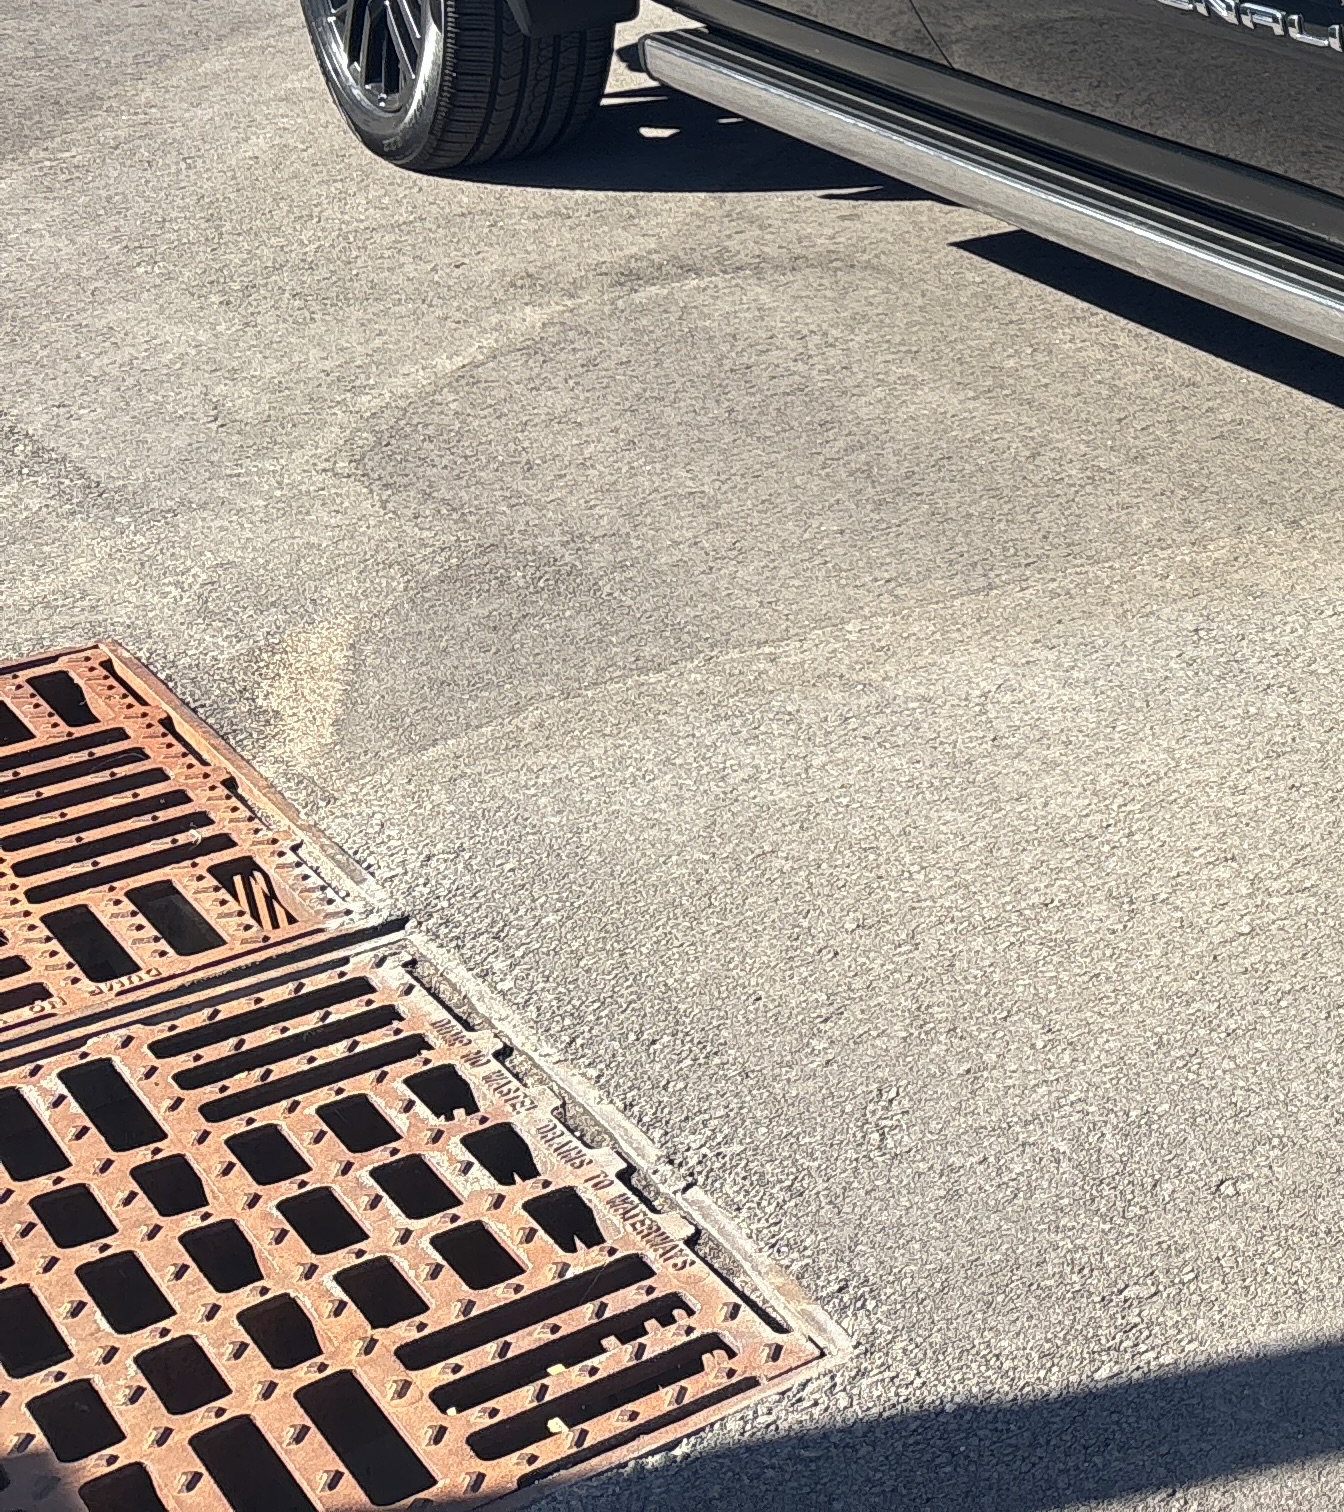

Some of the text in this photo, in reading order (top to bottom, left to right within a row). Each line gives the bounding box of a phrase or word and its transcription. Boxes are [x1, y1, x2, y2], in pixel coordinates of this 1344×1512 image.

[536, 1121, 594, 1170] DRAINS
[583, 1169, 615, 1191] TO
[606, 1191, 697, 1272] WATERWAYS
